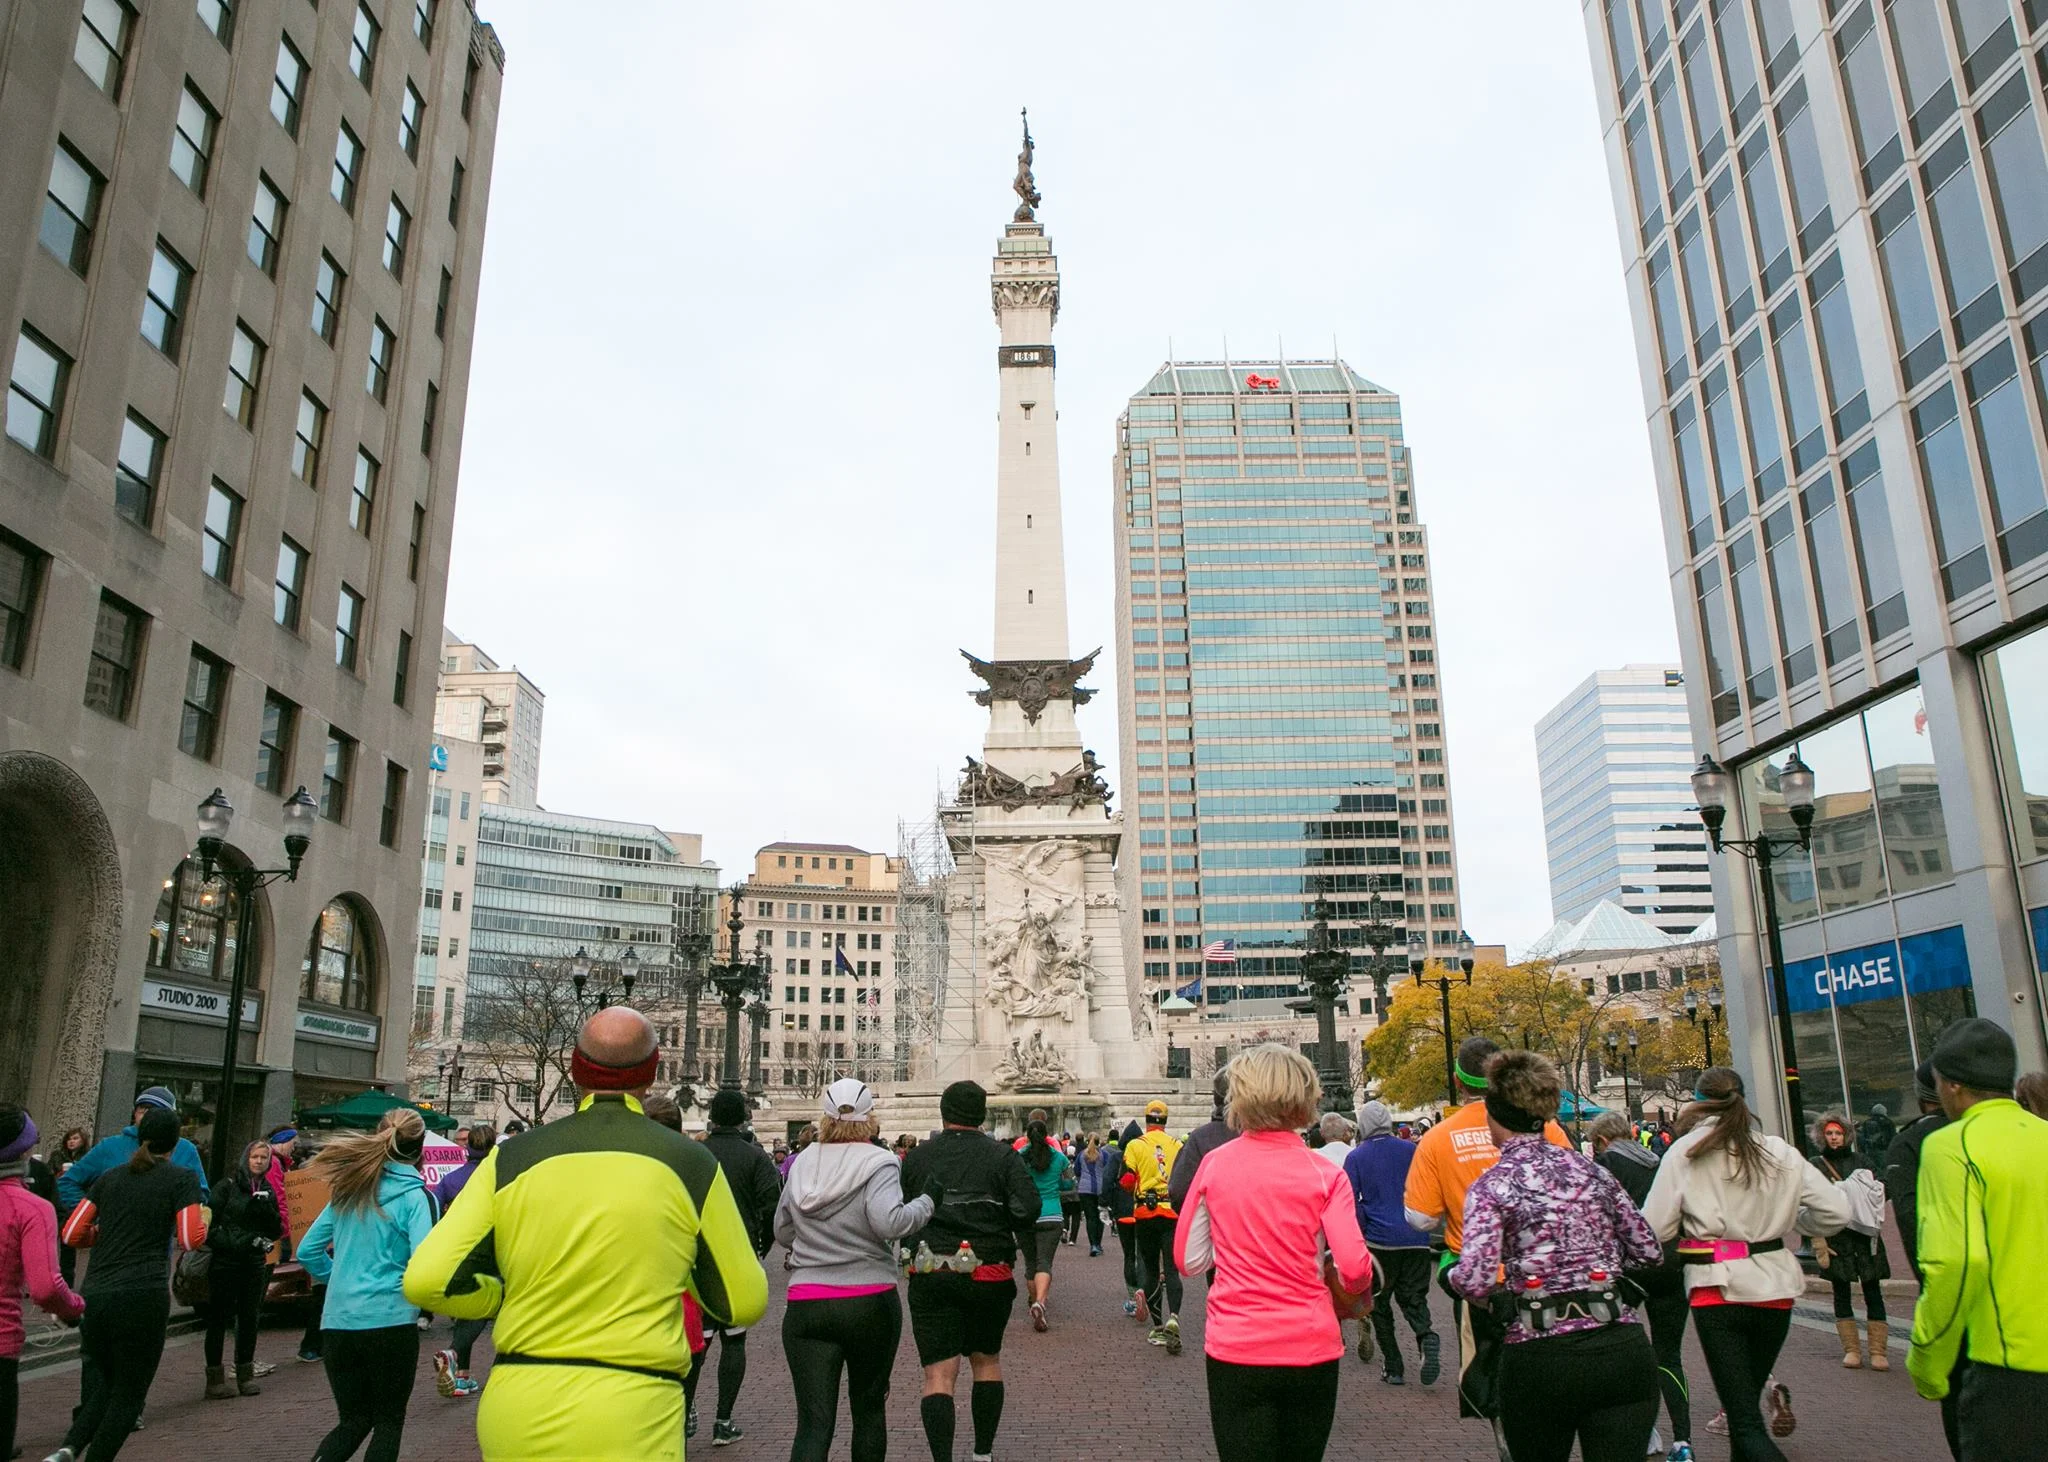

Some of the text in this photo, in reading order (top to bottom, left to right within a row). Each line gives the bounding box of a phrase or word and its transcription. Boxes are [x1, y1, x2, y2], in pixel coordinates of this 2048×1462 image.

[1814, 956, 1895, 995] CHASE
[158, 987, 194, 1006] STUDIO
[195, 994, 218, 1010] 2000
[1454, 1130, 1493, 1148] REGIS
[432, 1149, 463, 1161] SARAH
